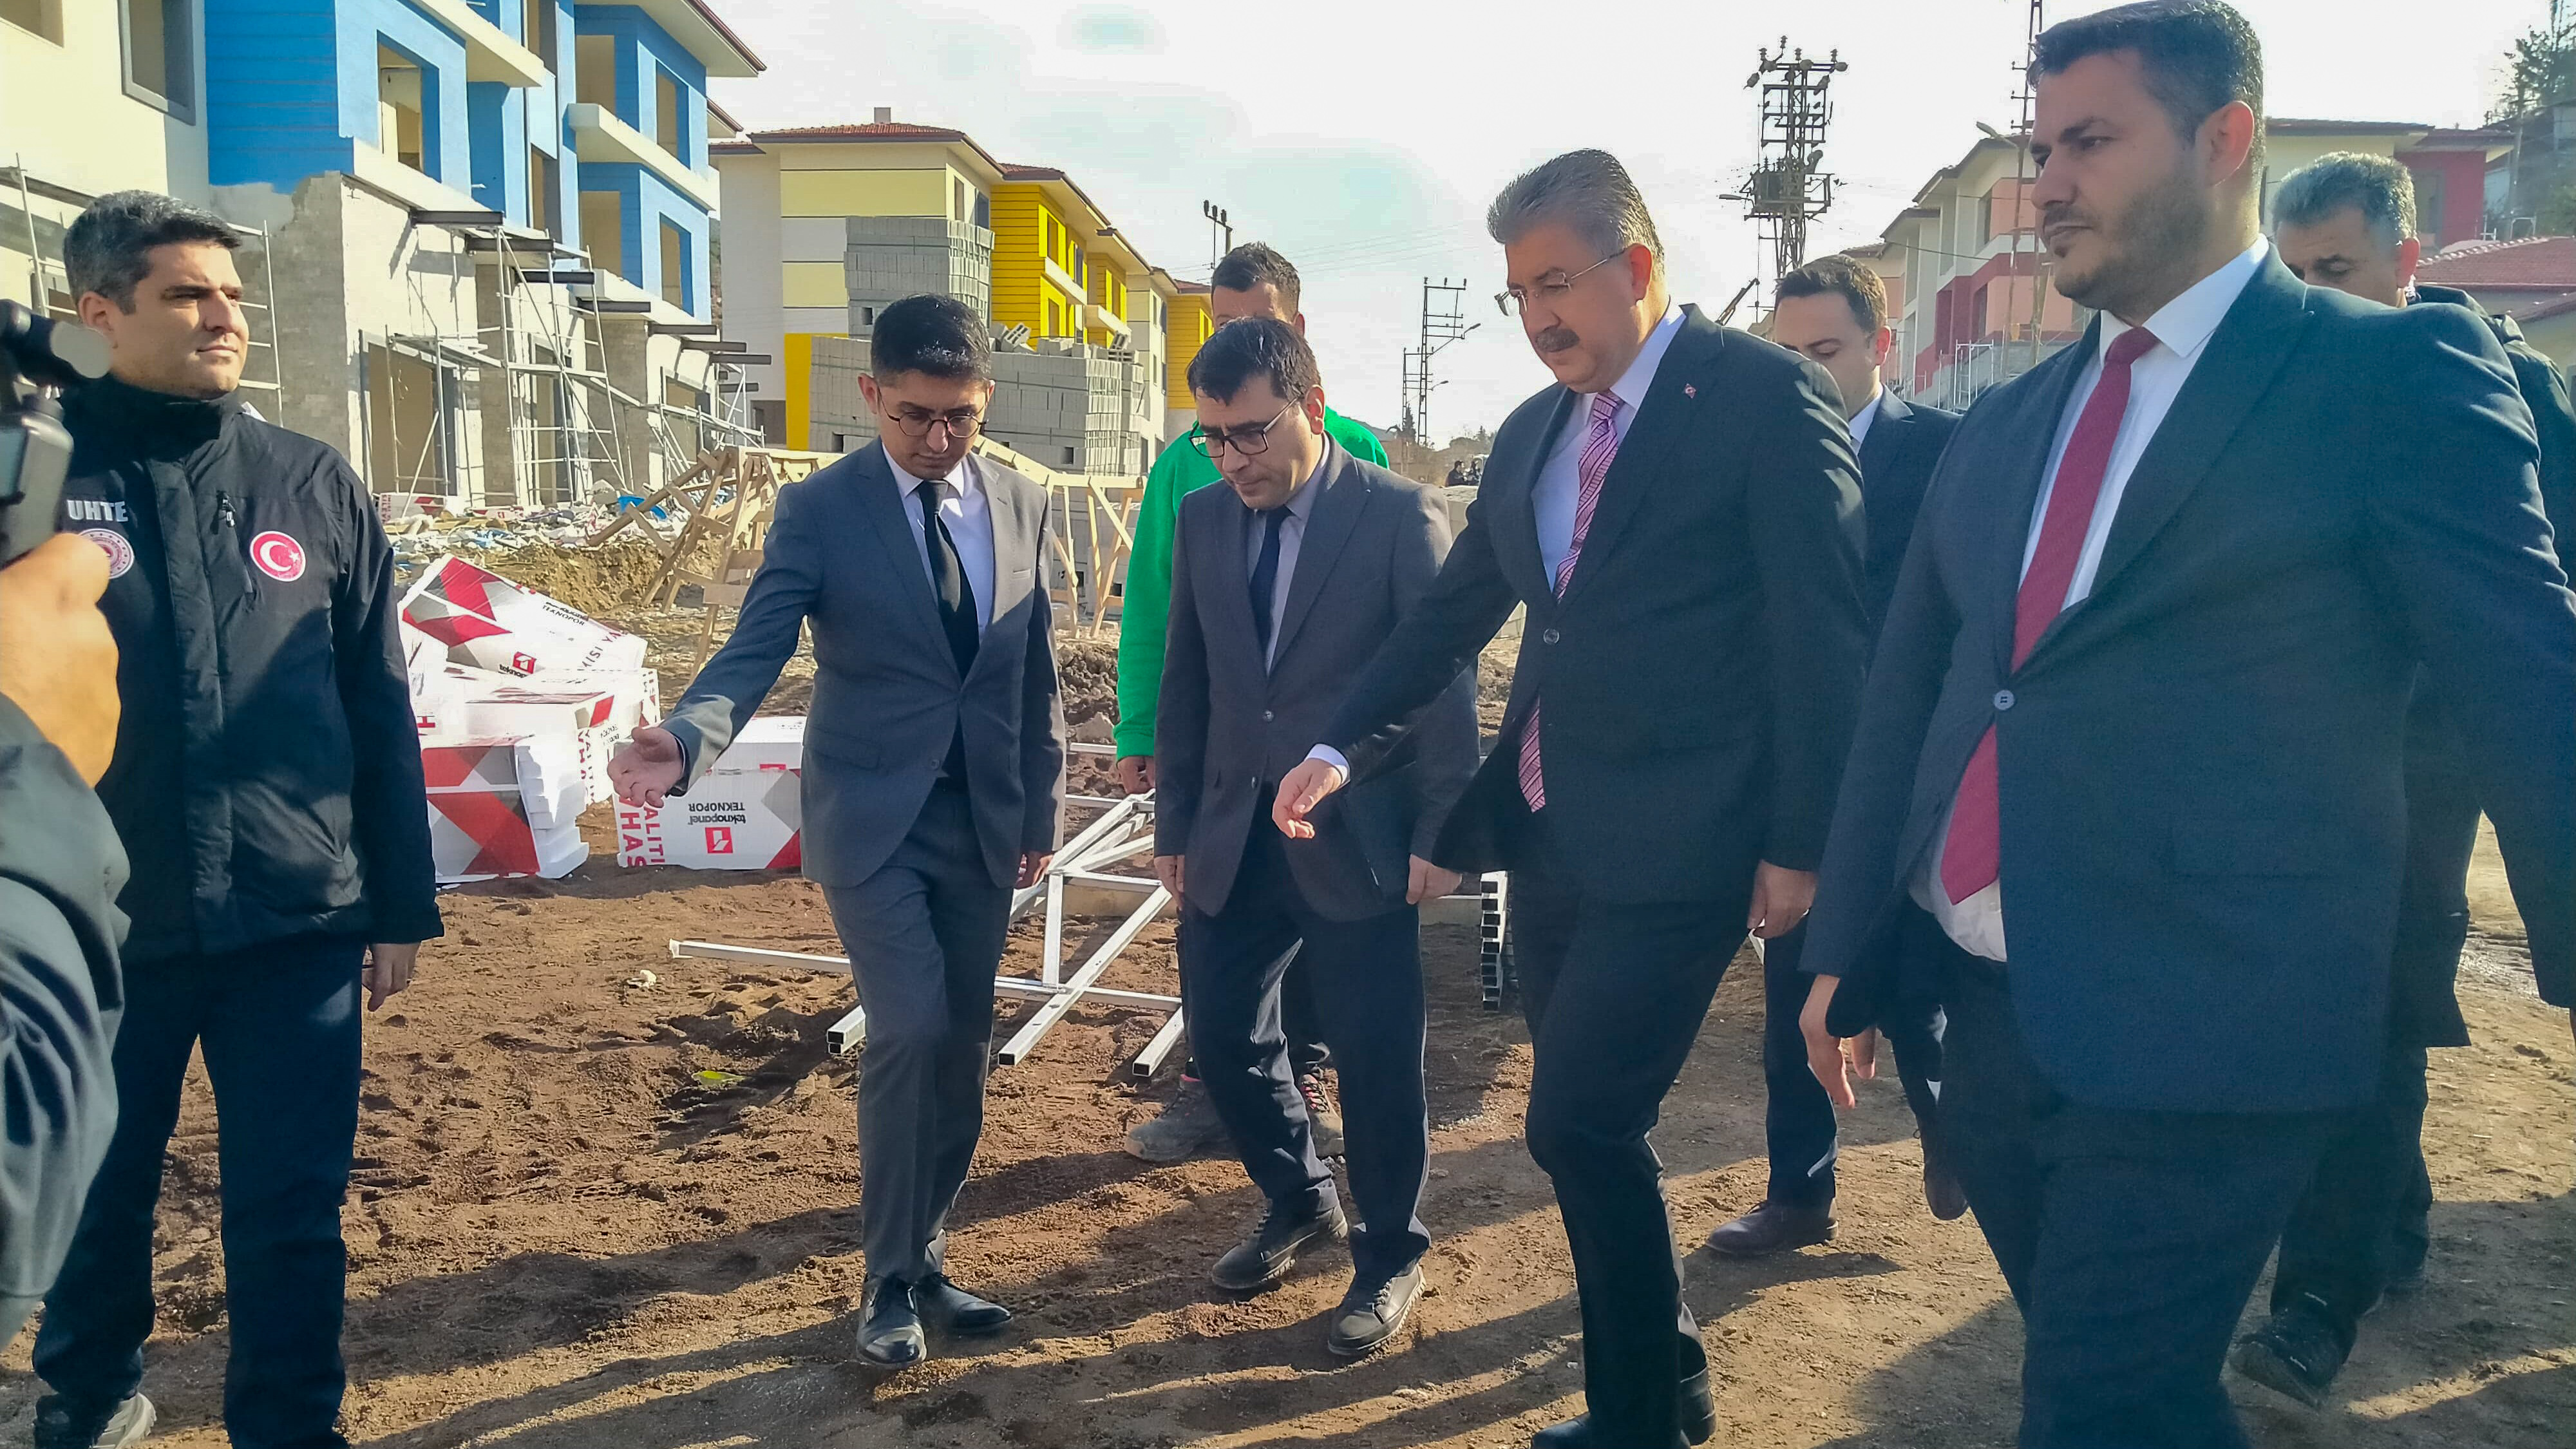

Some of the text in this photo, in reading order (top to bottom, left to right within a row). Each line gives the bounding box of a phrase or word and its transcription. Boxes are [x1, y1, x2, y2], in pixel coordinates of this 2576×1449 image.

[66, 499, 128, 522] UHTE
[688, 802, 746, 812] TEKNOPOR
[688, 814, 746, 826] teknopanel
[619, 800, 647, 867] HAS
